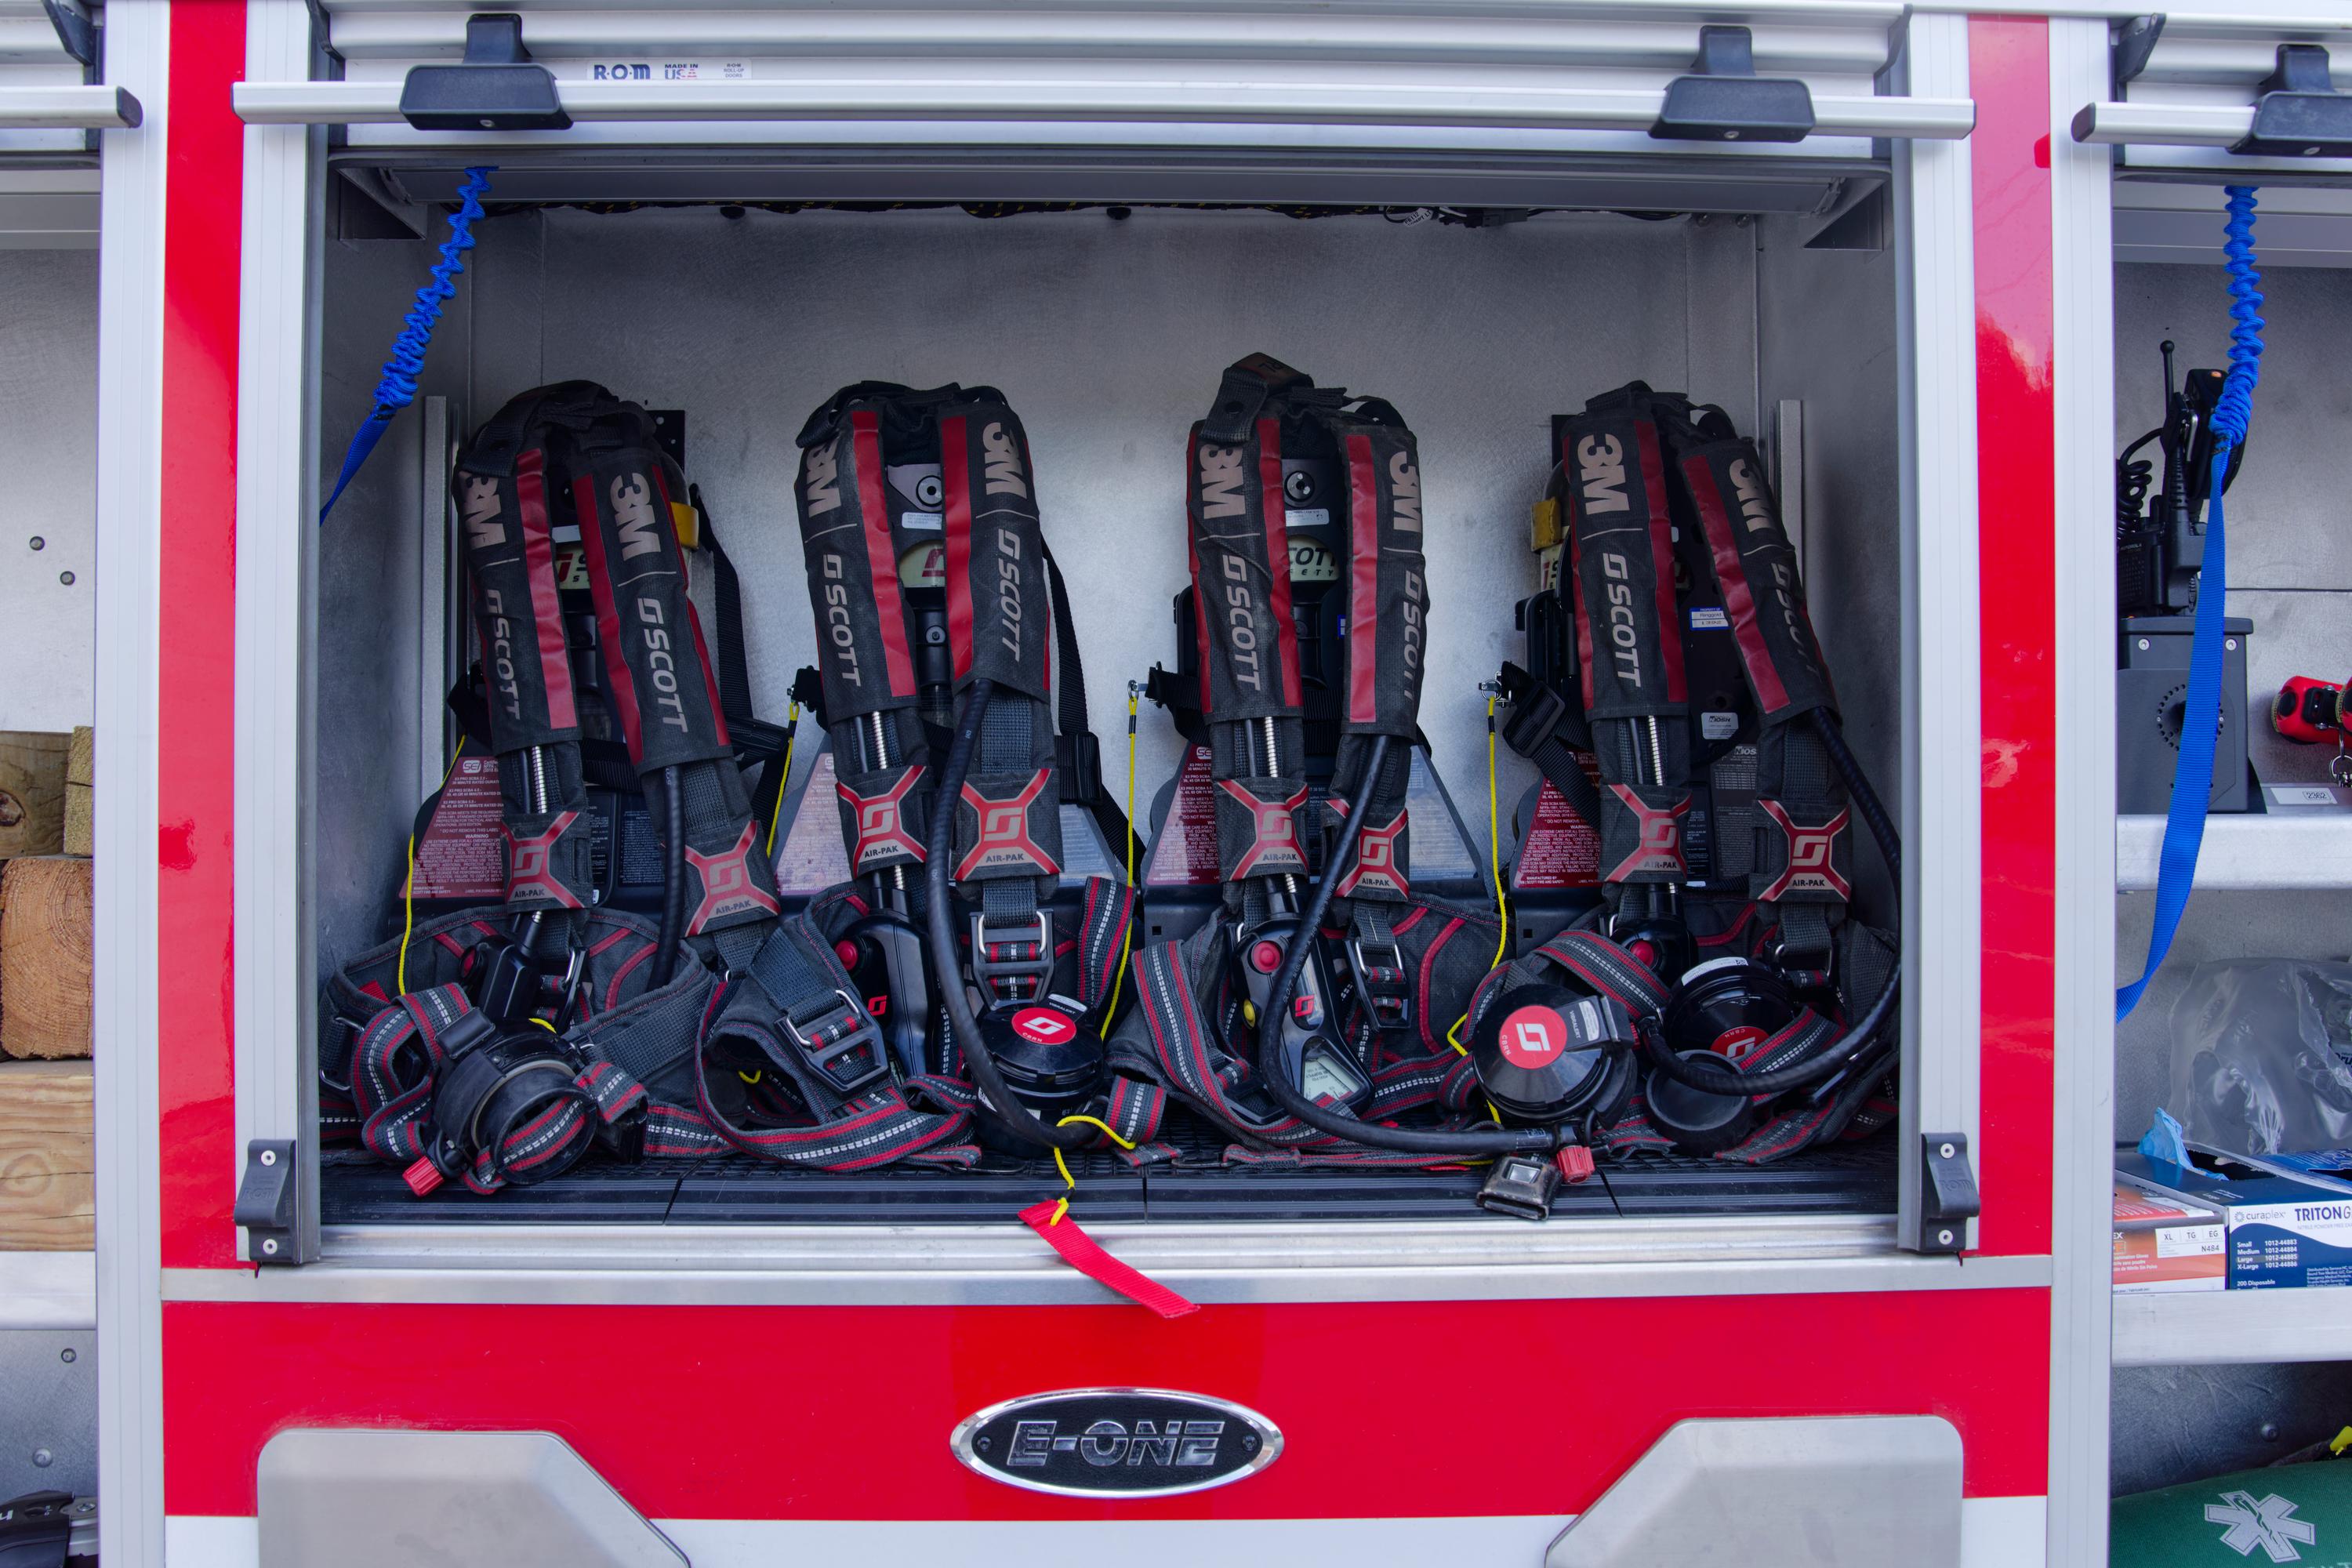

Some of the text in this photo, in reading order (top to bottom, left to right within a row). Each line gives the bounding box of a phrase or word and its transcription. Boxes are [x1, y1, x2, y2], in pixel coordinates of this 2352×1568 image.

[982, 422, 1028, 515] 3M
[1199, 444, 1247, 519] 3M
[1576, 433, 1630, 515] 3M
[807, 438, 841, 534] 3M
[1388, 451, 1422, 533] 3M
[459, 471, 506, 550] 3M
[610, 472, 661, 561] 3M
[997, 558, 1022, 662] SCOTT
[824, 584, 862, 687] SCOTT
[1226, 585, 1261, 691] SCOTT
[1606, 583, 1642, 688] SCOTT
[494, 617, 521, 720] SCOTT
[644, 629, 688, 733] SCOTT
[1735, 746, 1757, 755] NIOS
[865, 844, 898, 858] AIR-PAK
[985, 853, 1024, 863] AIR-PAK
[1262, 853, 1298, 862] AIR-PAK
[1644, 860, 1678, 870] AIR-PAK
[514, 888, 546, 898] AIR-PAK
[1362, 877, 1390, 887] AIR-PAK
[1792, 878, 1826, 887] AIR-PAK
[715, 900, 752, 916] AIR-PAK
[1022, 1032, 1043, 1043] CBRN
[1501, 1034, 1512, 1055] CBRN
[1724, 1029, 1746, 1039] CBRN
[2246, 1209, 2285, 1221] curaplex
[2201, 1244, 2220, 1253] N484
[1006, 1421, 1225, 1466] E-ONE
